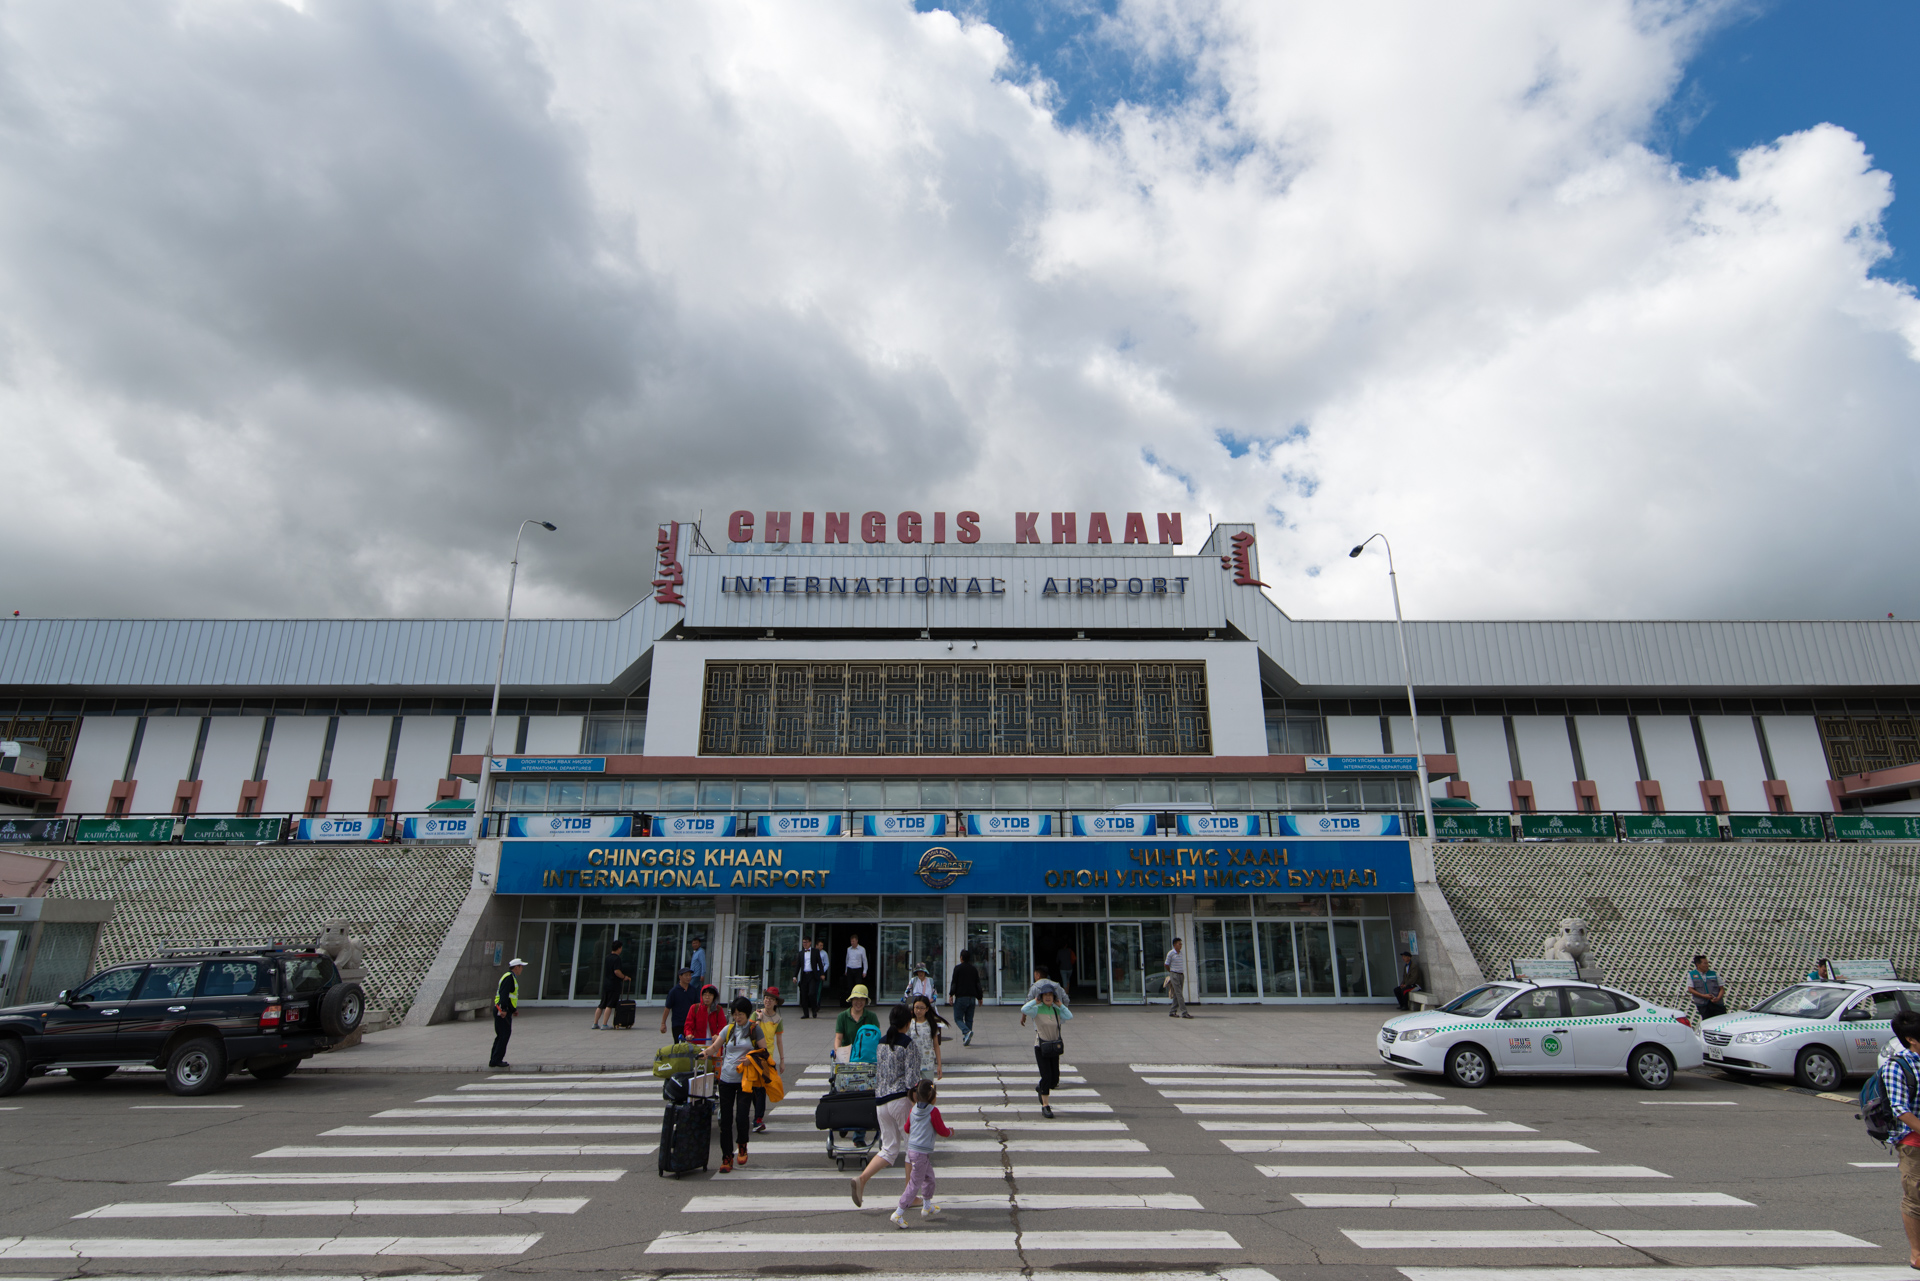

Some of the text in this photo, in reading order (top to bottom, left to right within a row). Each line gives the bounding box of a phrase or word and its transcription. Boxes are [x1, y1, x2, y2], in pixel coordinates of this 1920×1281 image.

[728, 510, 1184, 545] CHINGGIS KHAAN
[721, 576, 1190, 595] INTERNATIONAL AIRPORT
[332, 820, 362, 832] TDB
[437, 820, 467, 832] TDB
[563, 818, 591, 829] TDB
[686, 818, 715, 830] TDB
[790, 818, 820, 829] TDB
[896, 818, 925, 828] TDB
[1001, 818, 1030, 828] TDB
[1106, 818, 1134, 828] TDB
[1210, 818, 1238, 828] TDB
[1331, 818, 1360, 828] TDB
[194, 831, 223, 839] CAPITAL
[587, 848, 782, 867] CHINGGIS KHAAN
[1130, 848, 1288, 867] ЧИНГИС ХААН
[542, 869, 830, 888] INTERNATIONAL AIRPORT
[1044, 868, 1378, 890] ОЛОН УЛСЫН НИСЭХ БУУДАЛ
